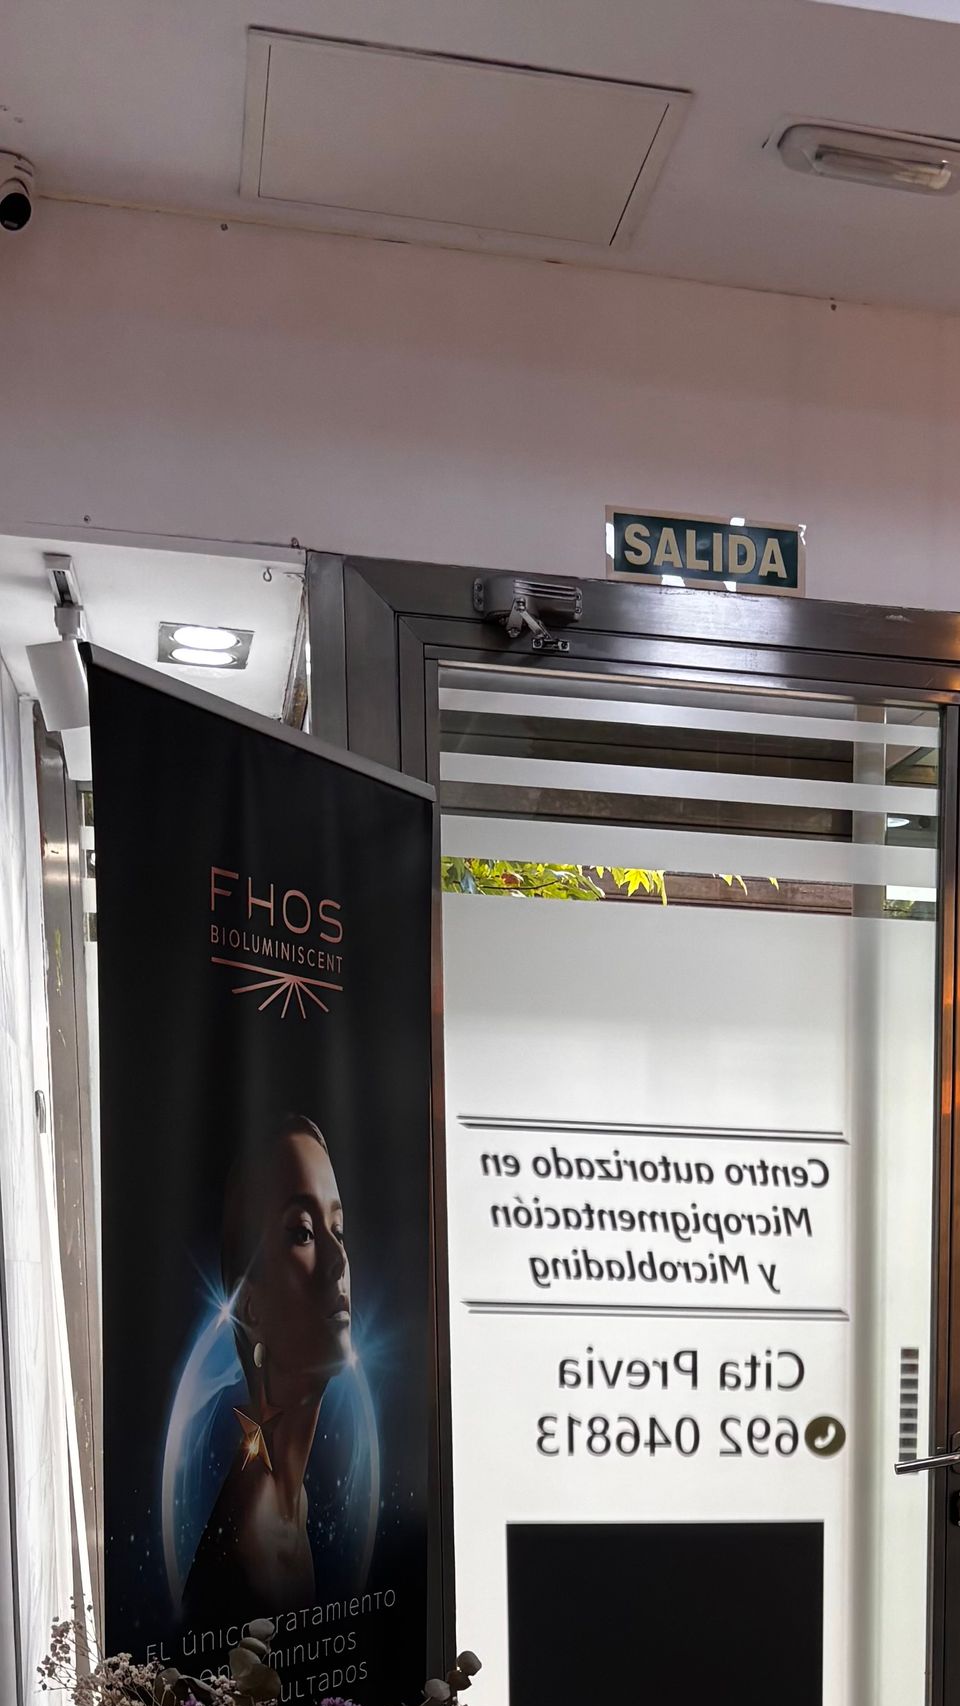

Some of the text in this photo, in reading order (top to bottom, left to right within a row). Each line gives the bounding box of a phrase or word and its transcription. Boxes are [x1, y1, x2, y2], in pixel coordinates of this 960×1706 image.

[623, 522, 788, 580] SALIDA
[210, 866, 344, 944] FHOS
[210, 925, 344, 974] BIOLUMINISCENT
